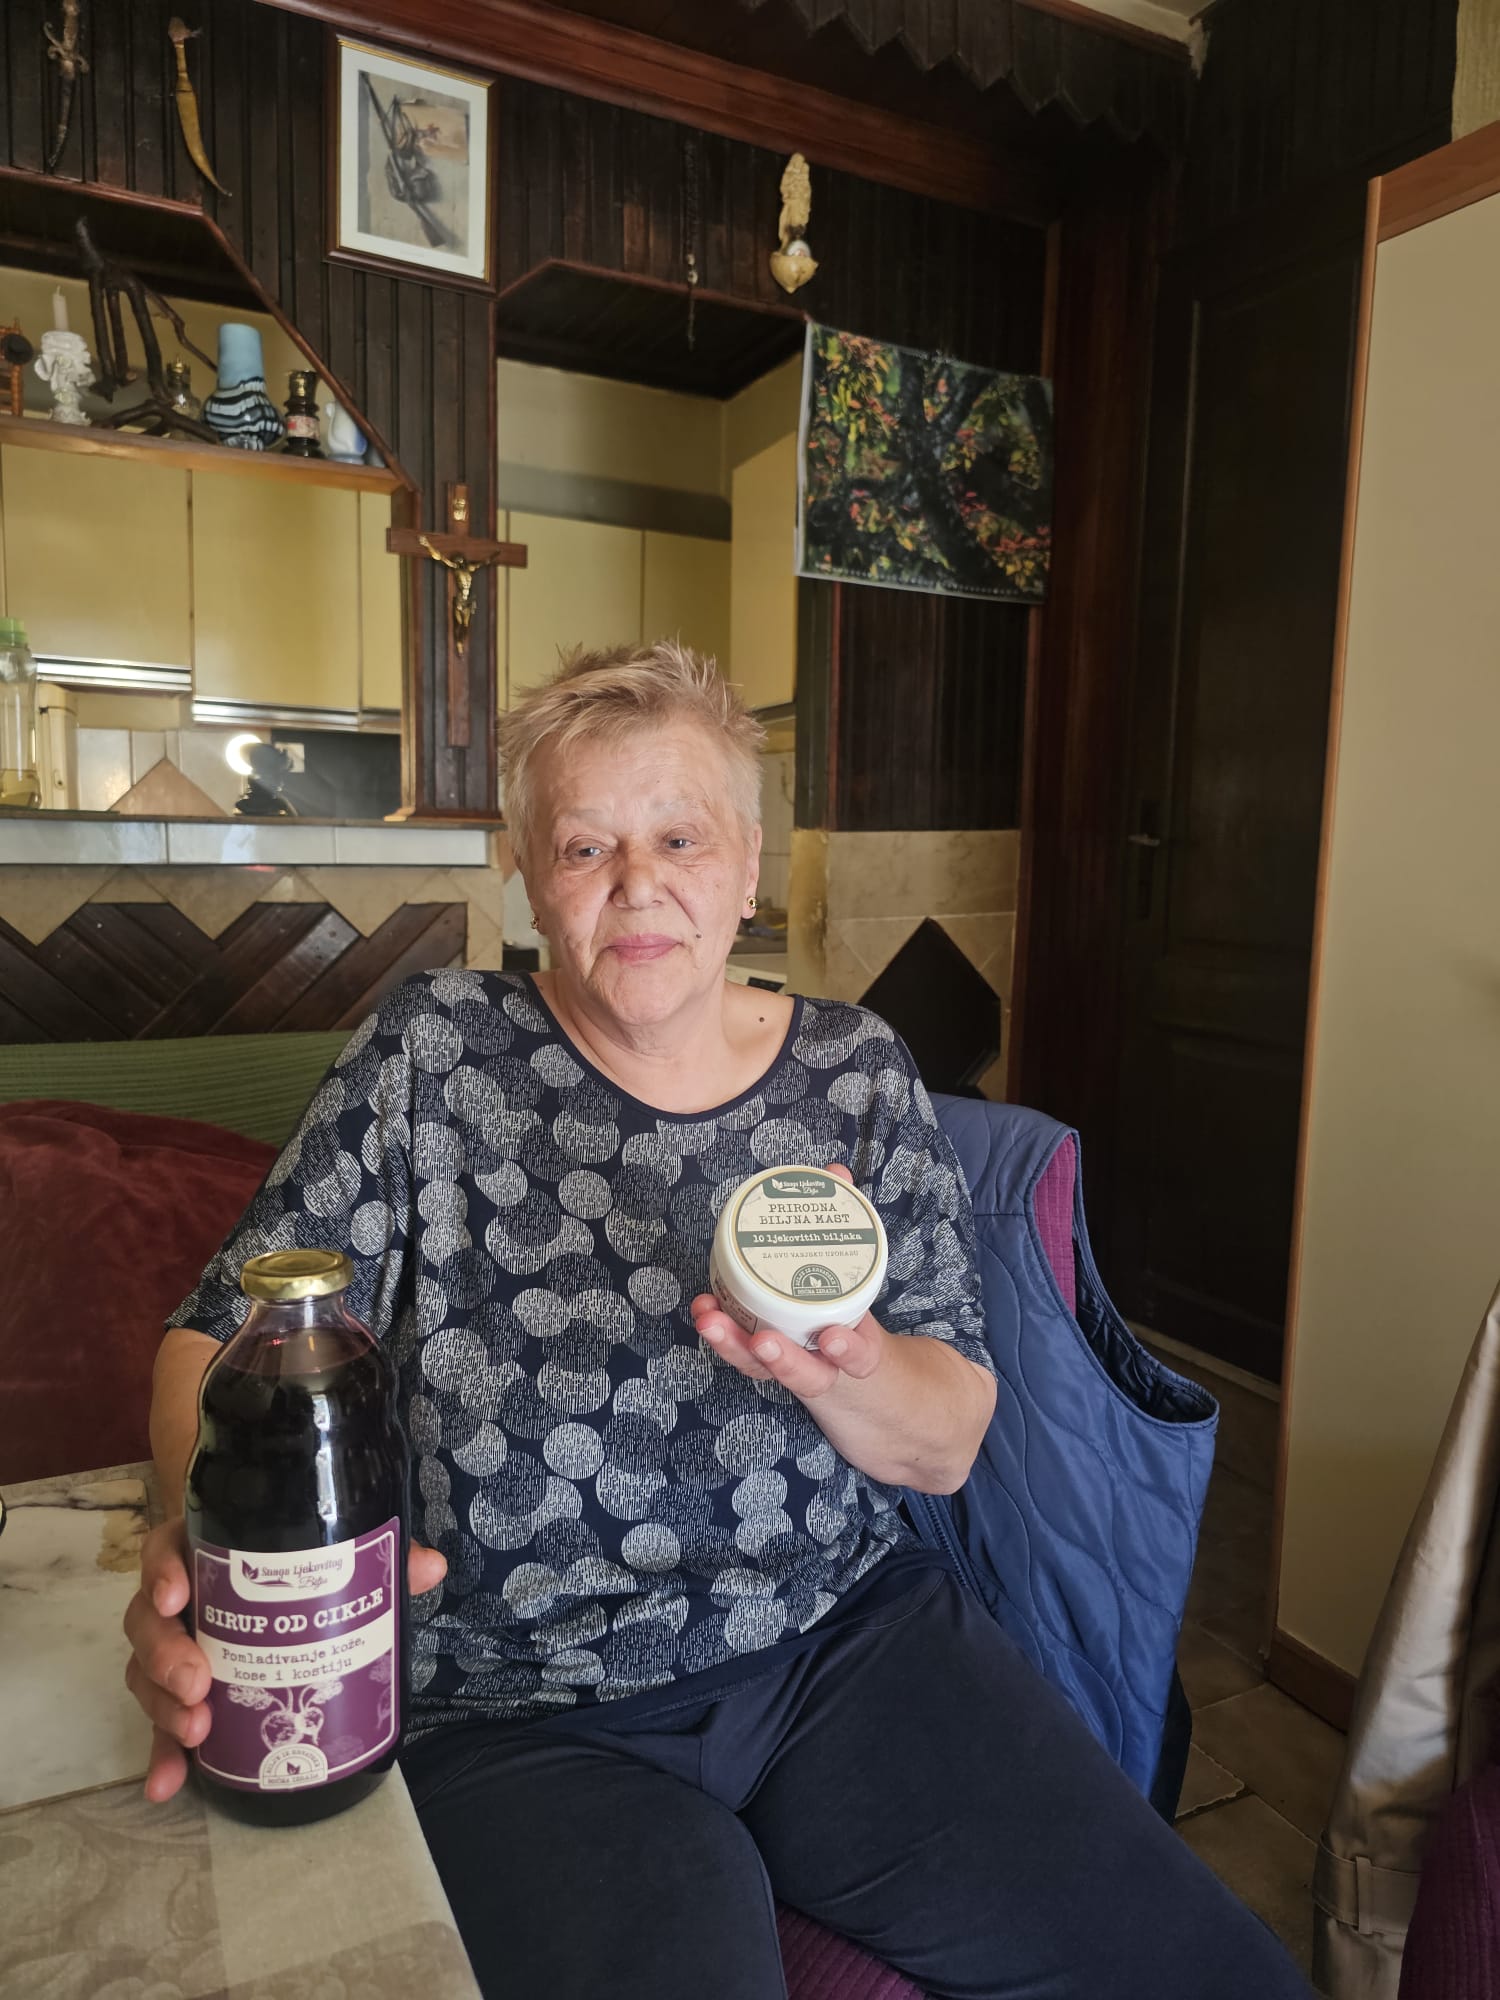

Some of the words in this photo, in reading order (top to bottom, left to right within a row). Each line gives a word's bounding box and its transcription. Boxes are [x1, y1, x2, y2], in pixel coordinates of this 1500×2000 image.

[768, 1203, 837, 1213] PRIRODNA
[759, 1215, 811, 1225] BILJNA
[815, 1214, 850, 1224] MAST
[753, 1235, 765, 1243] 10
[767, 1233, 820, 1243] ljekovitih
[822, 1232, 862, 1242] biljaka
[204, 1604, 268, 1634] SIRUP
[274, 1614, 308, 1634] OD
[313, 1587, 384, 1628] CIKLE
[234, 1667, 267, 1681] kose
[275, 1670, 283, 1681] i
[292, 1657, 352, 1680] kostiju
